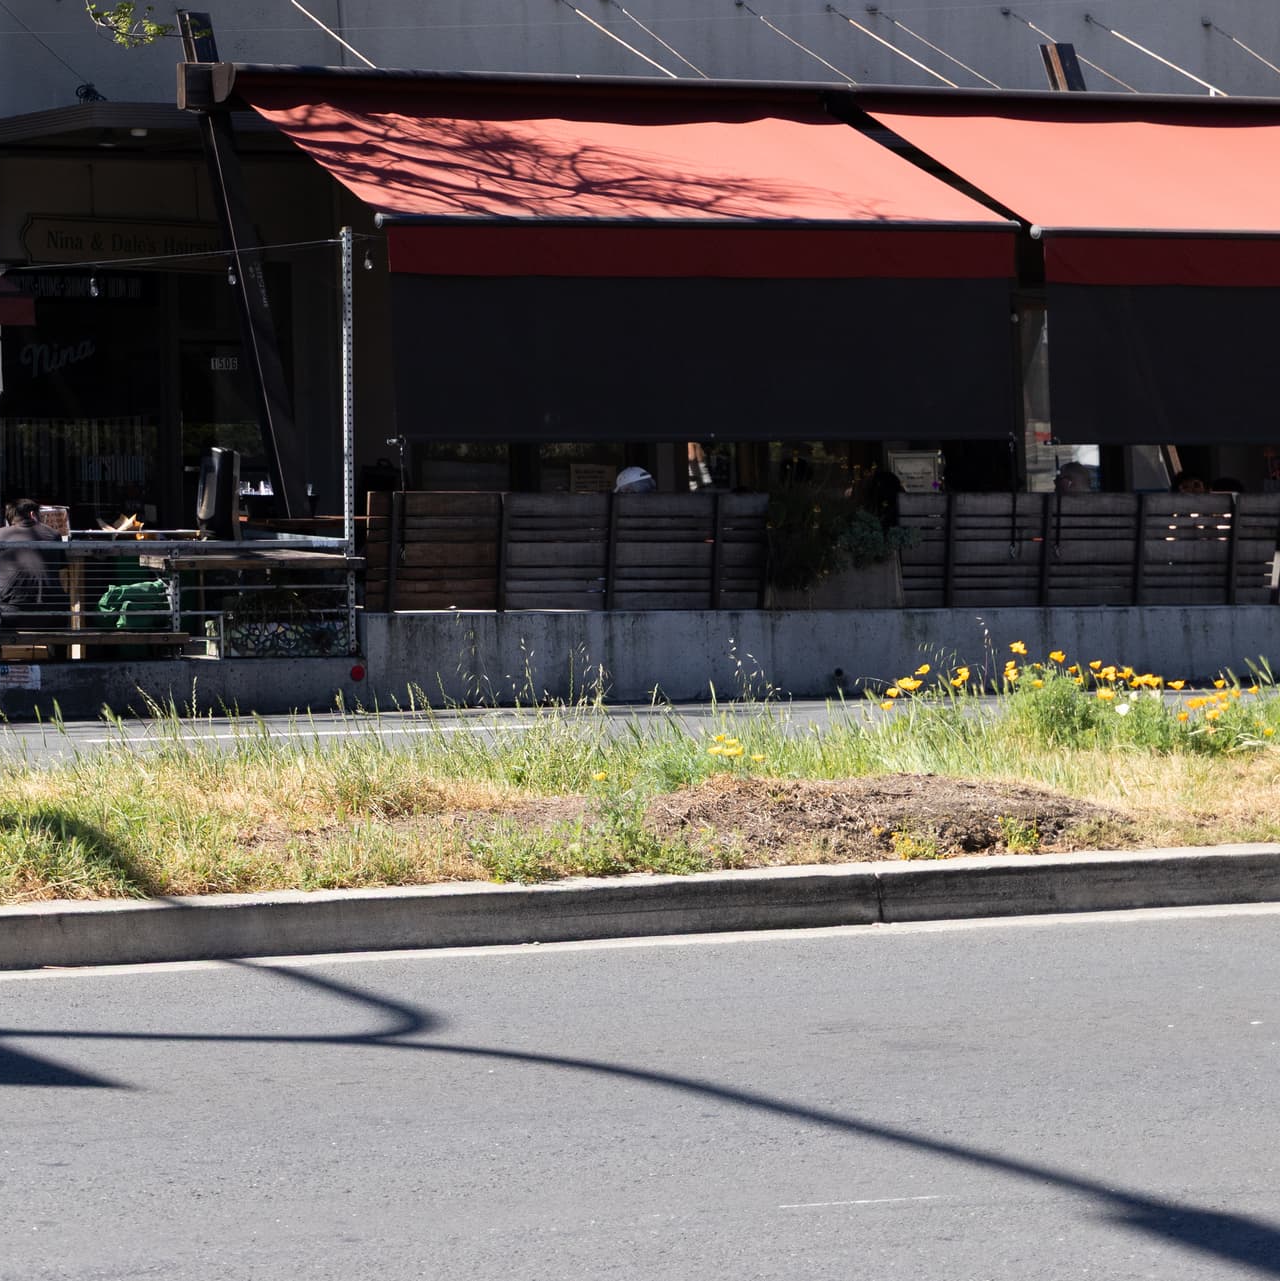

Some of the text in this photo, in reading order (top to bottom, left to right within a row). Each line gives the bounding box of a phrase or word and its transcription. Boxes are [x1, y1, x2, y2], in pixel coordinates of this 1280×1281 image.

[46, 230, 83, 250] Nina
[91, 232, 104, 251] &
[19, 339, 96, 378] Nina
[211, 357, 238, 370] 1506
